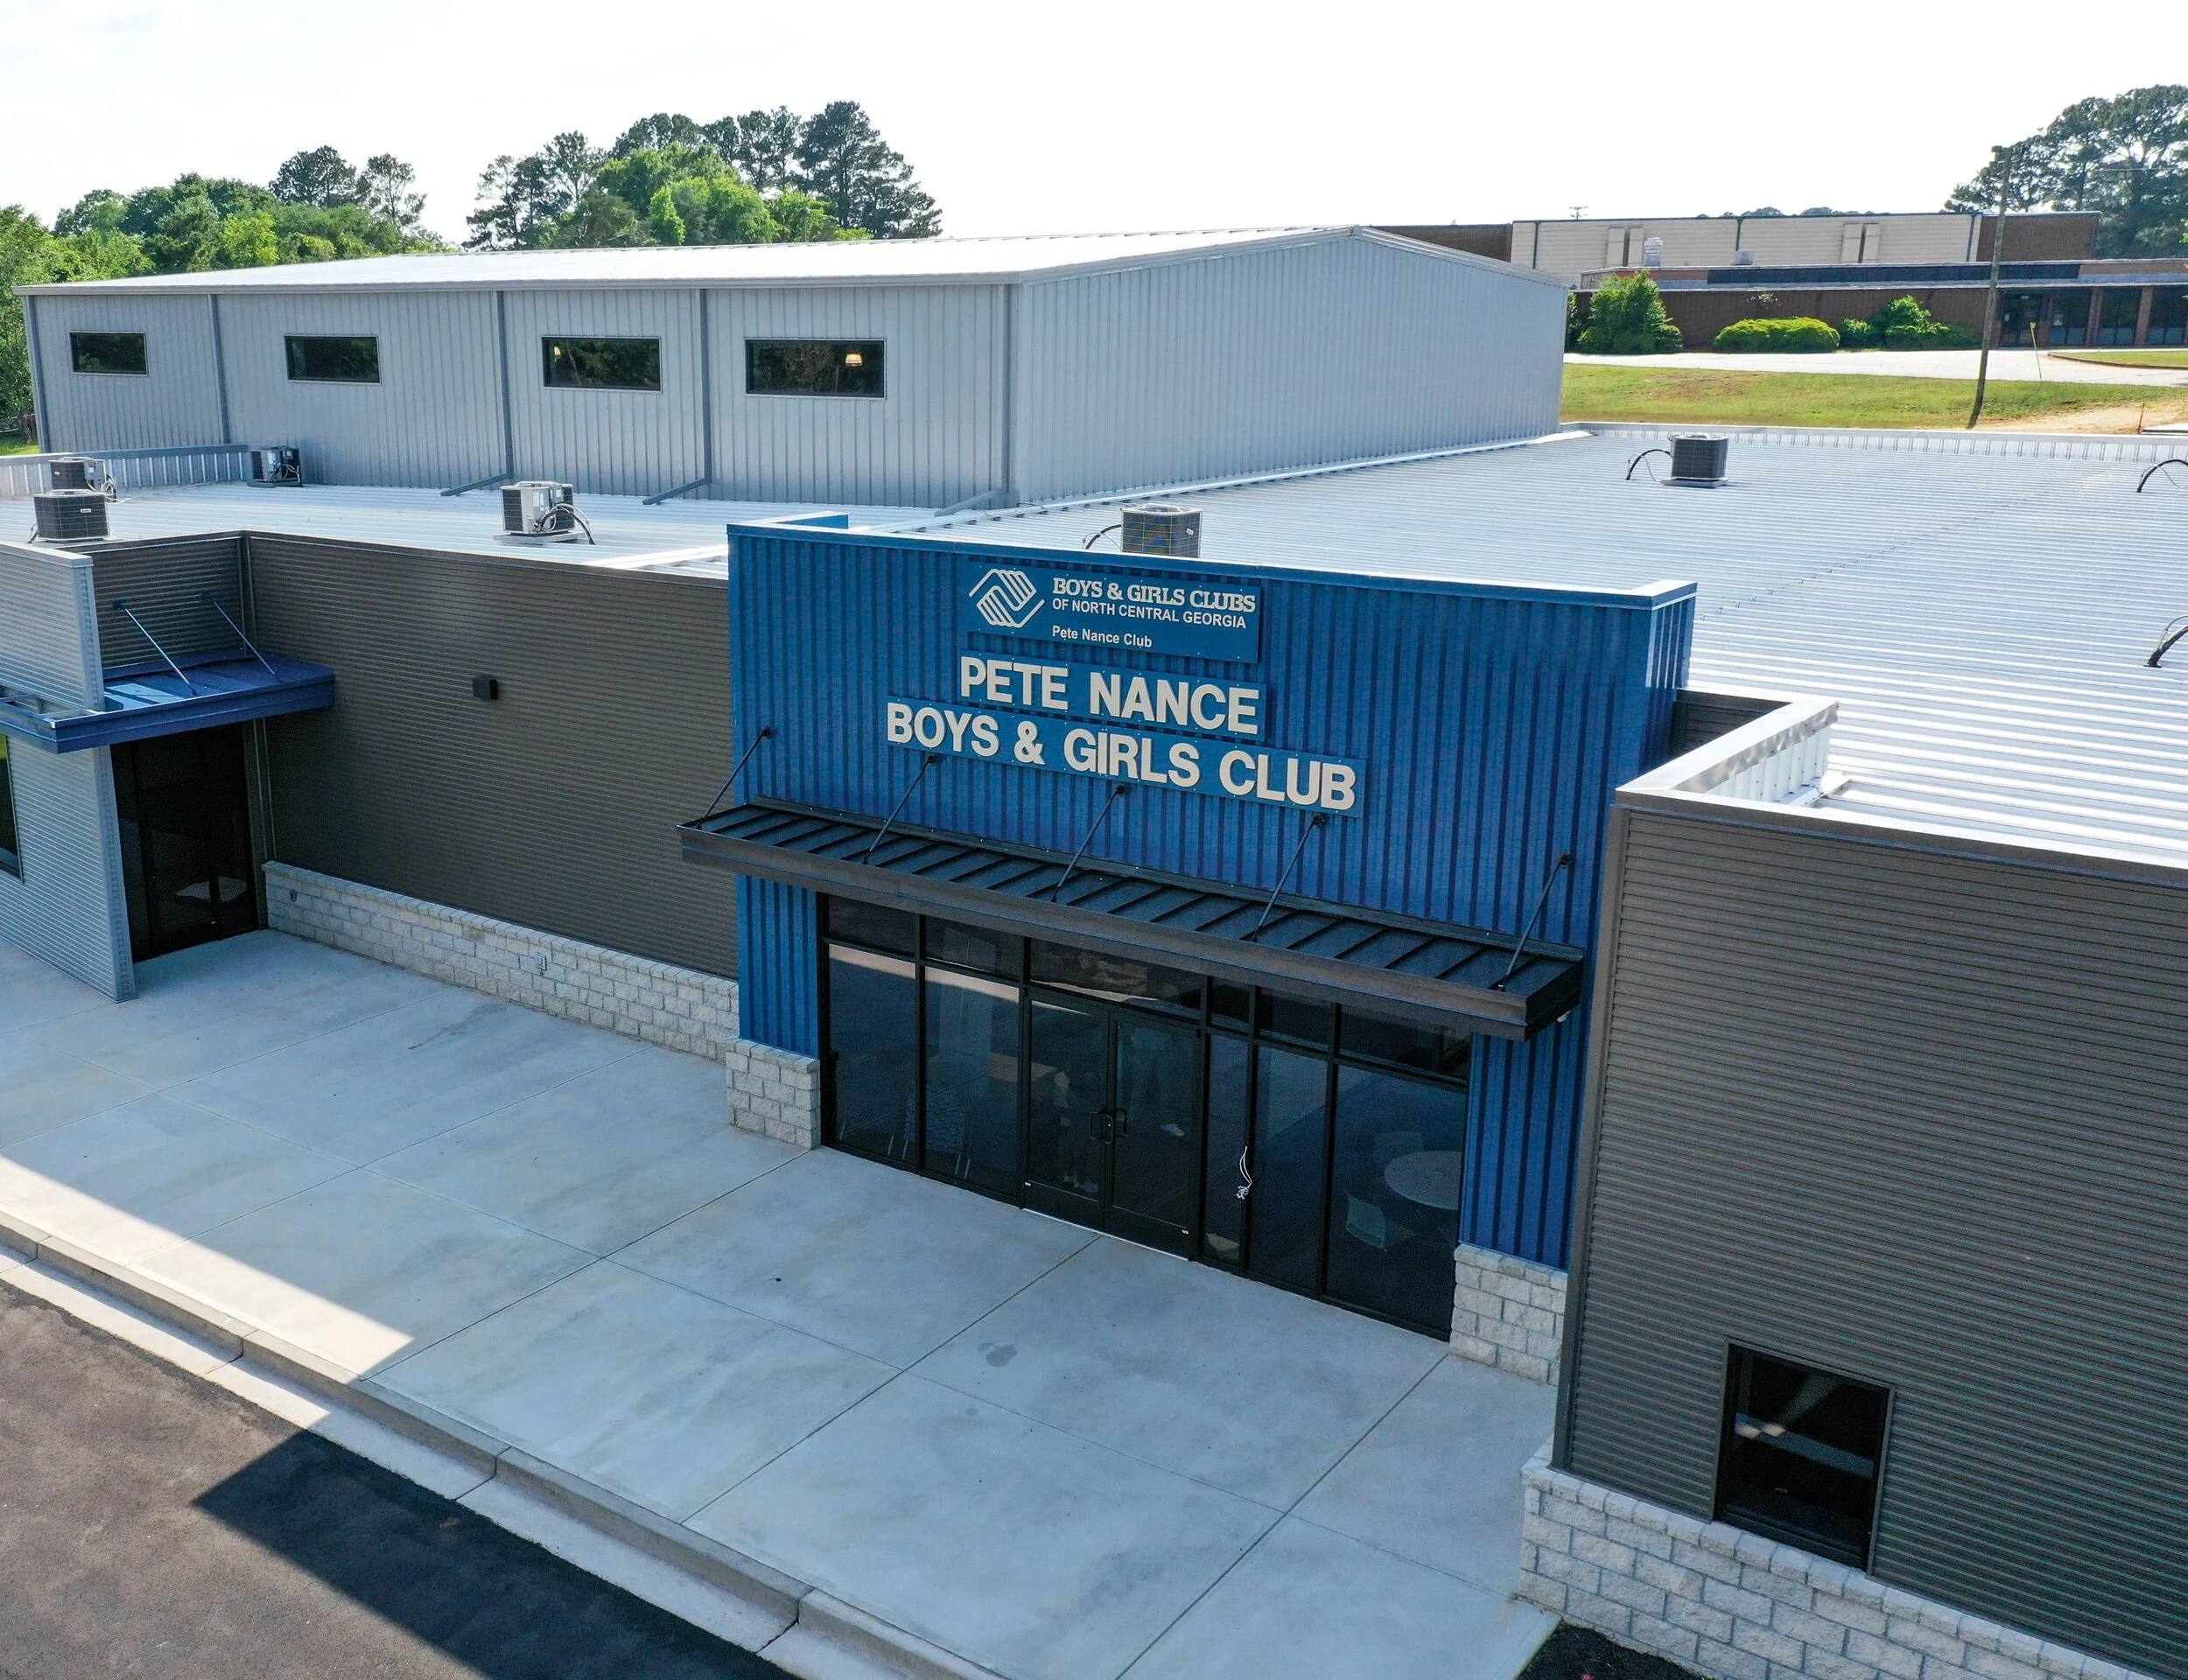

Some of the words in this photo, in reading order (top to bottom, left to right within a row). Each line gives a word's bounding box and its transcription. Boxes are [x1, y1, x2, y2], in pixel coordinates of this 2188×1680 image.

[1053, 578, 1103, 598] BOYS
[1106, 583, 1124, 600] &
[1127, 584, 1185, 606] GIRLS
[1189, 590, 1256, 612] CLUBS
[1052, 598, 1069, 611] OF
[1072, 599, 1115, 615] NORTH
[1119, 605, 1180, 622] CENTRAL
[1182, 611, 1246, 629] GEORGIA
[1052, 625, 1078, 640] Pete
[1082, 628, 1120, 644] Nance
[1123, 633, 1152, 648] Club
[961, 656, 1069, 710] PETE
[1090, 671, 1259, 735] NANCE
[887, 702, 999, 757] BOYS
[1013, 720, 1046, 765] &
[1063, 728, 1200, 788] GIRLS
[1219, 750, 1356, 810] CLUB
